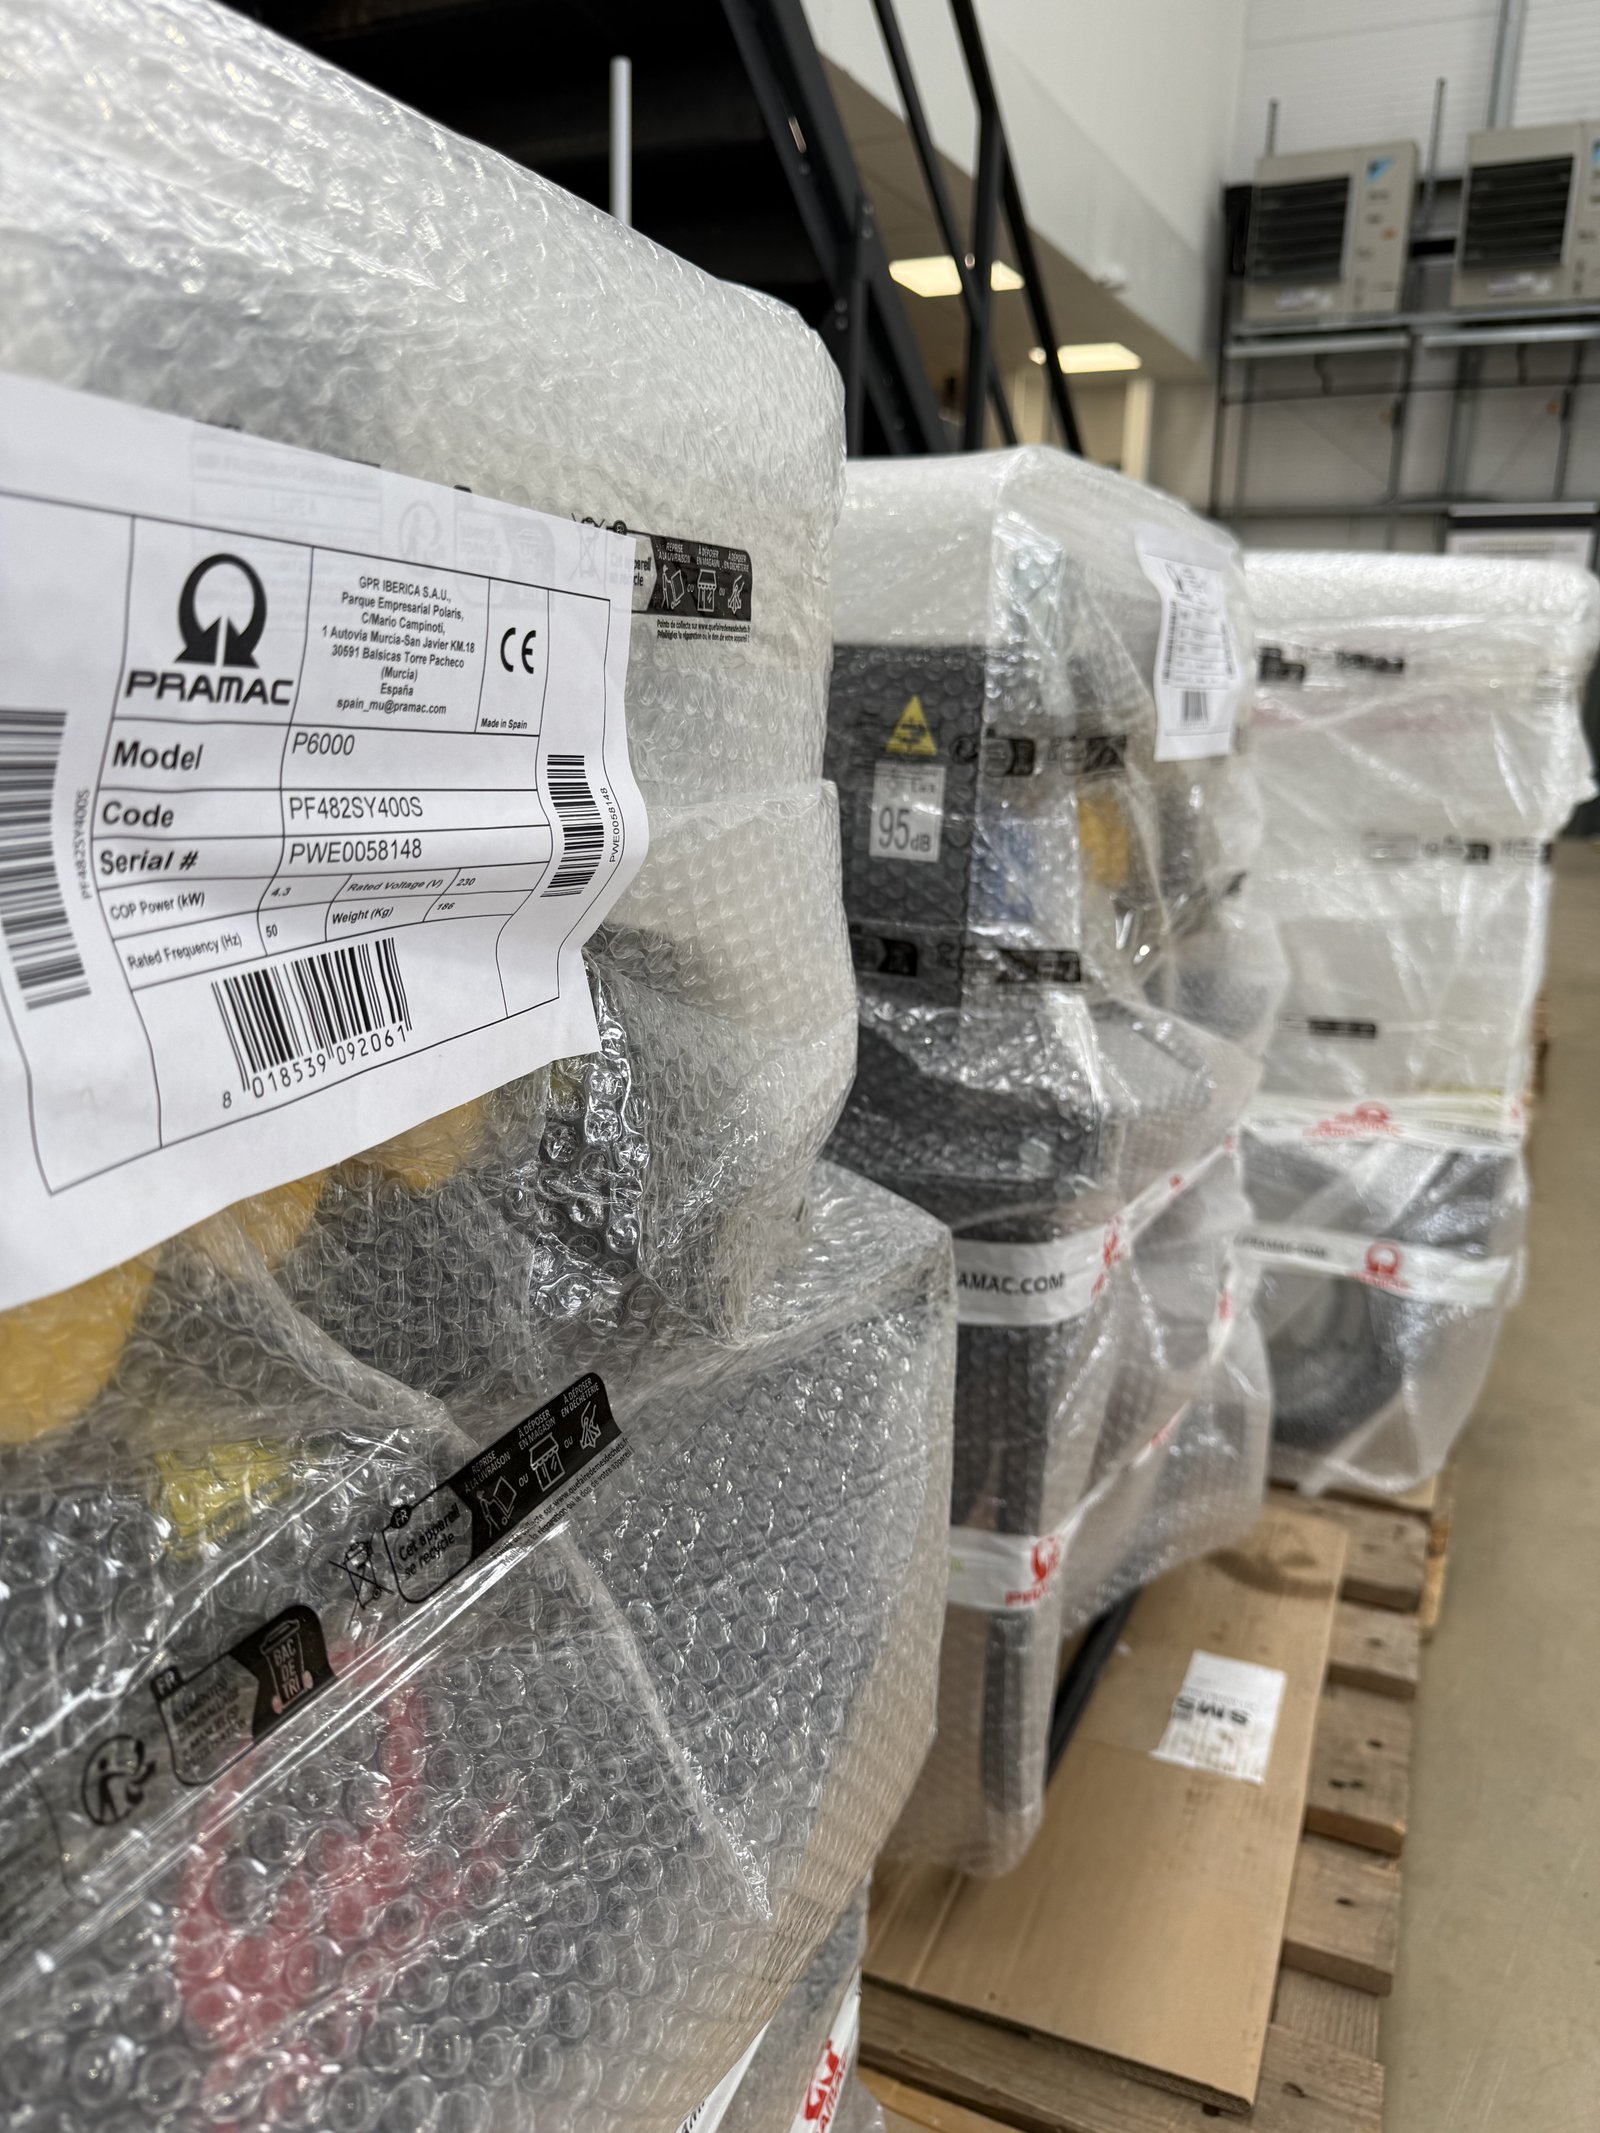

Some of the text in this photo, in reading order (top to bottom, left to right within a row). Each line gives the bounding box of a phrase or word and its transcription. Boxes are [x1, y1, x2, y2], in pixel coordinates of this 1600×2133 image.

[359, 576, 452, 603] GPR IBERICA S.A.U.,
[341, 591, 464, 622] Parque Empresarial Polaris,
[361, 612, 446, 636] C/Mario Campinoti,
[322, 625, 475, 654] 1 Autovia Murcia-San Javier KM.18
[332, 644, 465, 669] 30591 Balsicas Torre Pacheco
[381, 666, 418, 682] (Murcia)
[125, 670, 293, 706] PRAMAC
[380, 682, 414, 697] España
[336, 698, 447, 714] spain_mu@pramac.com
[481, 718, 528, 731] Made in Spain
[112, 740, 204, 771] Model
[292, 732, 355, 756] P6000
[102, 800, 174, 829] Code
[289, 796, 423, 820] PF482SY400S
[600, 787, 621, 863] PWE0058148
[879, 806, 932, 852] 95 dB
[100, 850, 199, 876] Serial #
[289, 838, 422, 865] PWE0058148
[271, 887, 291, 898] 4.3
[347, 879, 444, 893] Rated Voltage (V)
[456, 877, 476, 887] 230
[109, 892, 205, 922] COP Power (kW)
[332, 906, 394, 925] Weight (Kg)
[436, 902, 456, 911] 186
[265, 924, 278, 939] 50
[127, 932, 243, 971] Rated Frequency (Hz)
[222, 1025, 408, 1109] 8 018539 092061
[528, 1417, 556, 1445] MAGASIN
[471, 1450, 496, 1474] REPRISE
[479, 1452, 511, 1483] LIVRAISON
[518, 1473, 529, 1488] OU
[400, 1541, 418, 1561] Cet
[273, 1639, 296, 1666] BAC
[156, 1671, 175, 1695] FR
[281, 1662, 296, 1683] DE
[282, 1680, 301, 1700] TRI
